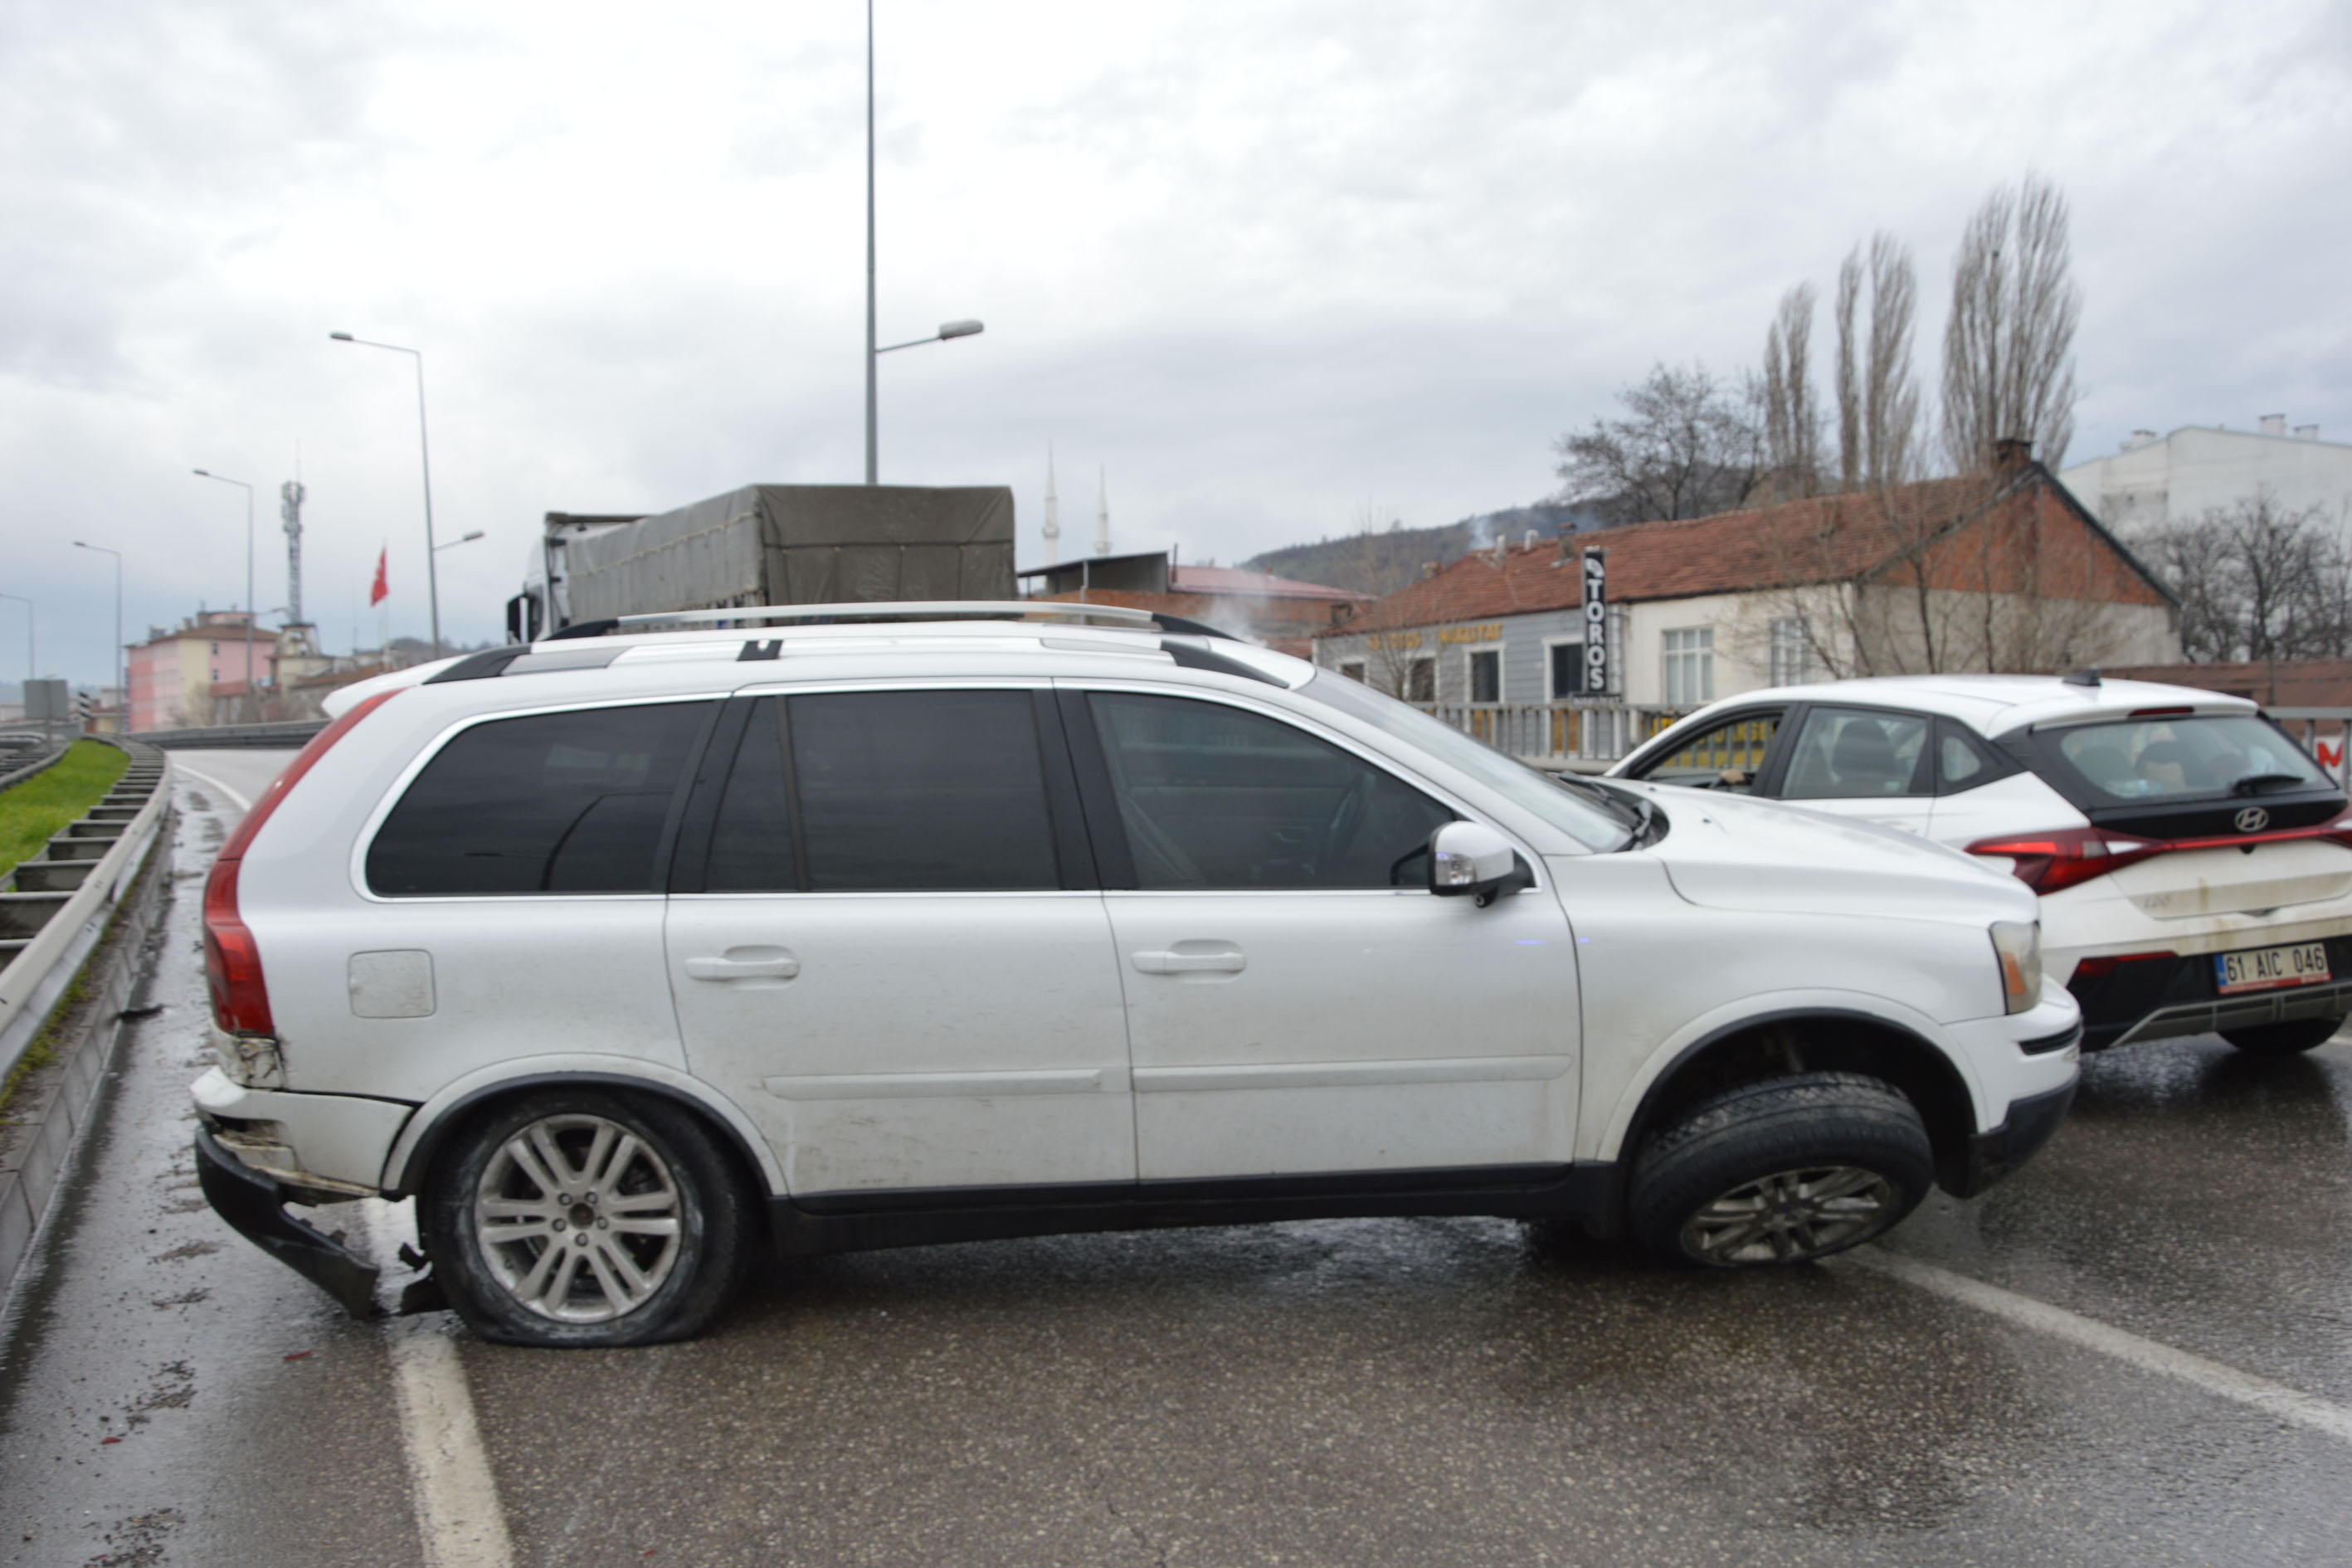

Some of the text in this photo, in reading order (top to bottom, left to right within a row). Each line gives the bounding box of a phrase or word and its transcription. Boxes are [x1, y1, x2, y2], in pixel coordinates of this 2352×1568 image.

[1586, 578, 1606, 689] TOROS
[2225, 946, 2325, 981] 61 AIC 046
